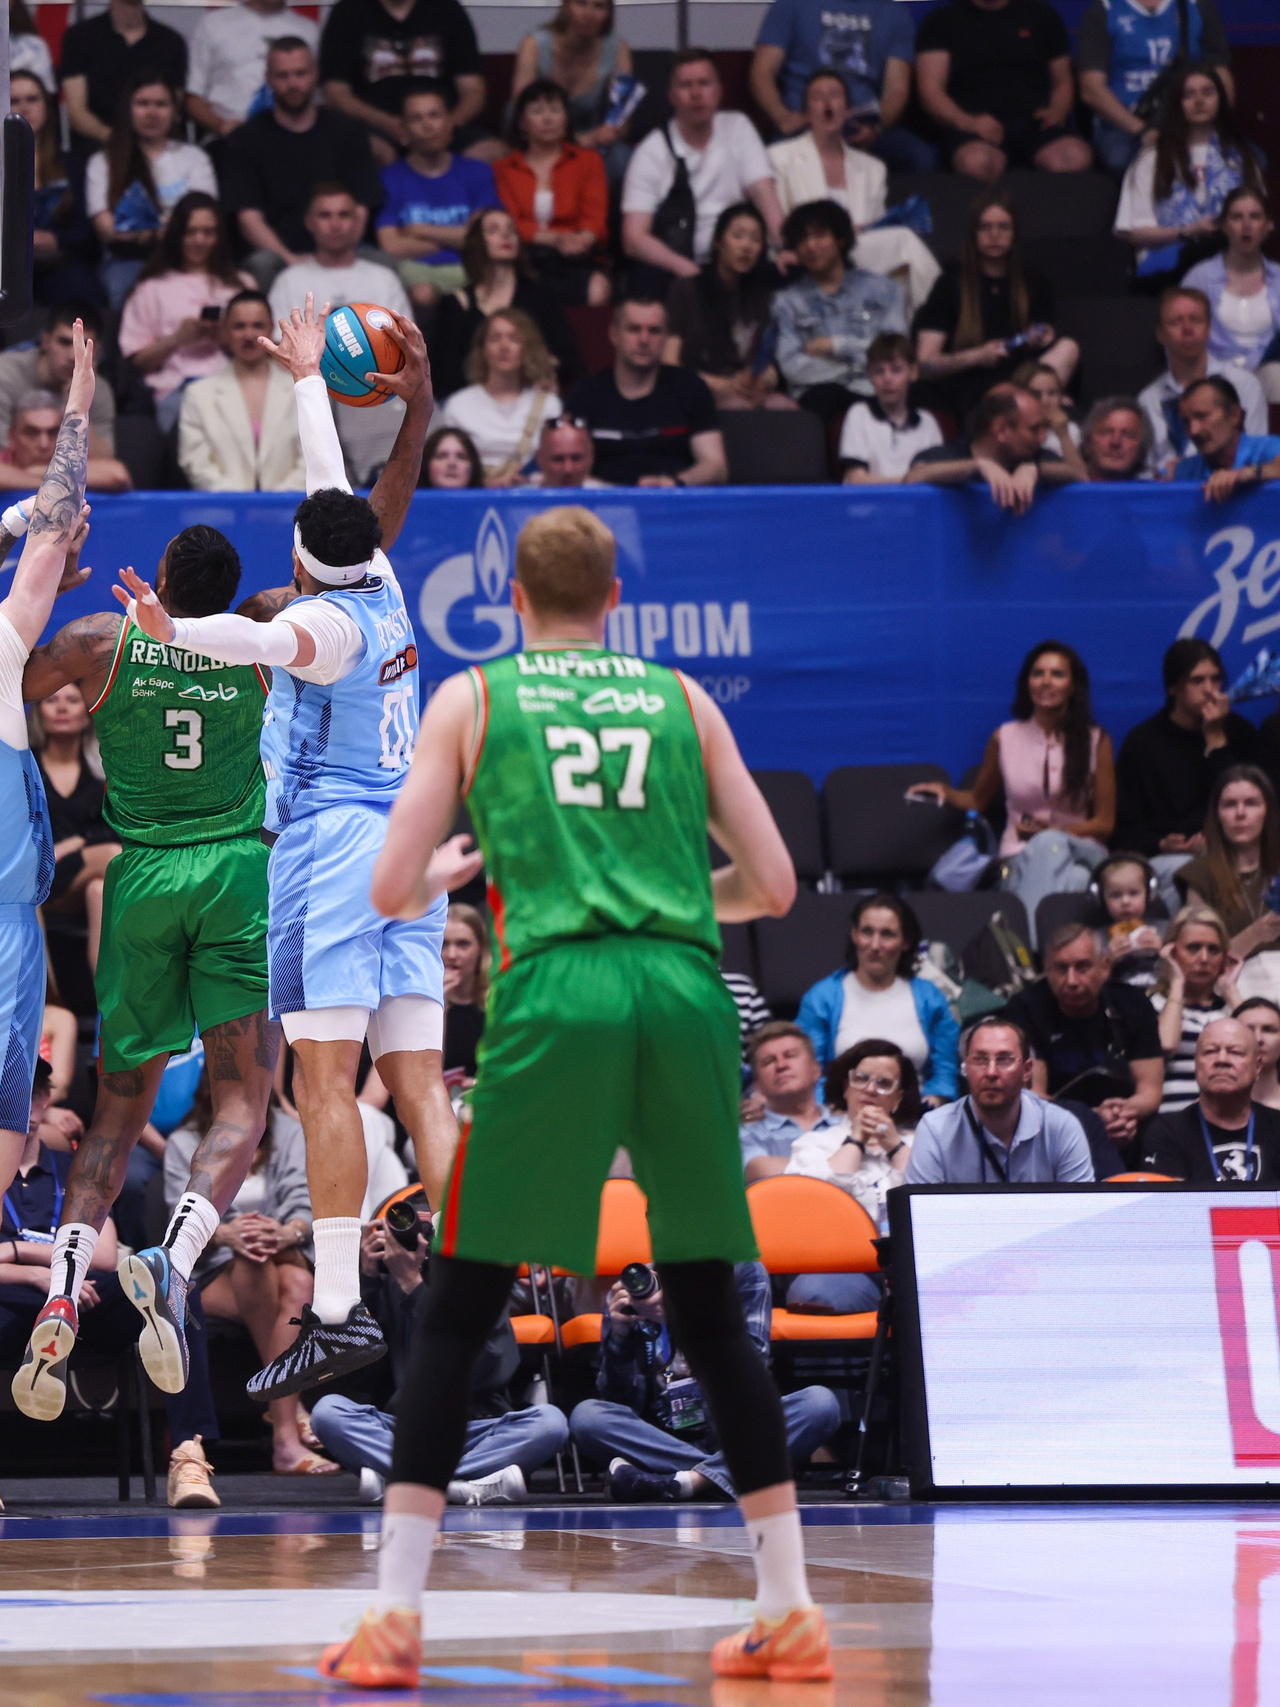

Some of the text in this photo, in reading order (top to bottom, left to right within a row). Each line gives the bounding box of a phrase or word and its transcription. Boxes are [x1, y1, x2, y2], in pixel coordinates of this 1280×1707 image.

[332, 312, 364, 358] SIBUR
[608, 602, 752, 658] ПРОМ
[131, 688, 157, 697] Банк
[132, 677, 175, 690] Ак Барс
[164, 709, 202, 770] 3
[544, 725, 652, 808] 27
